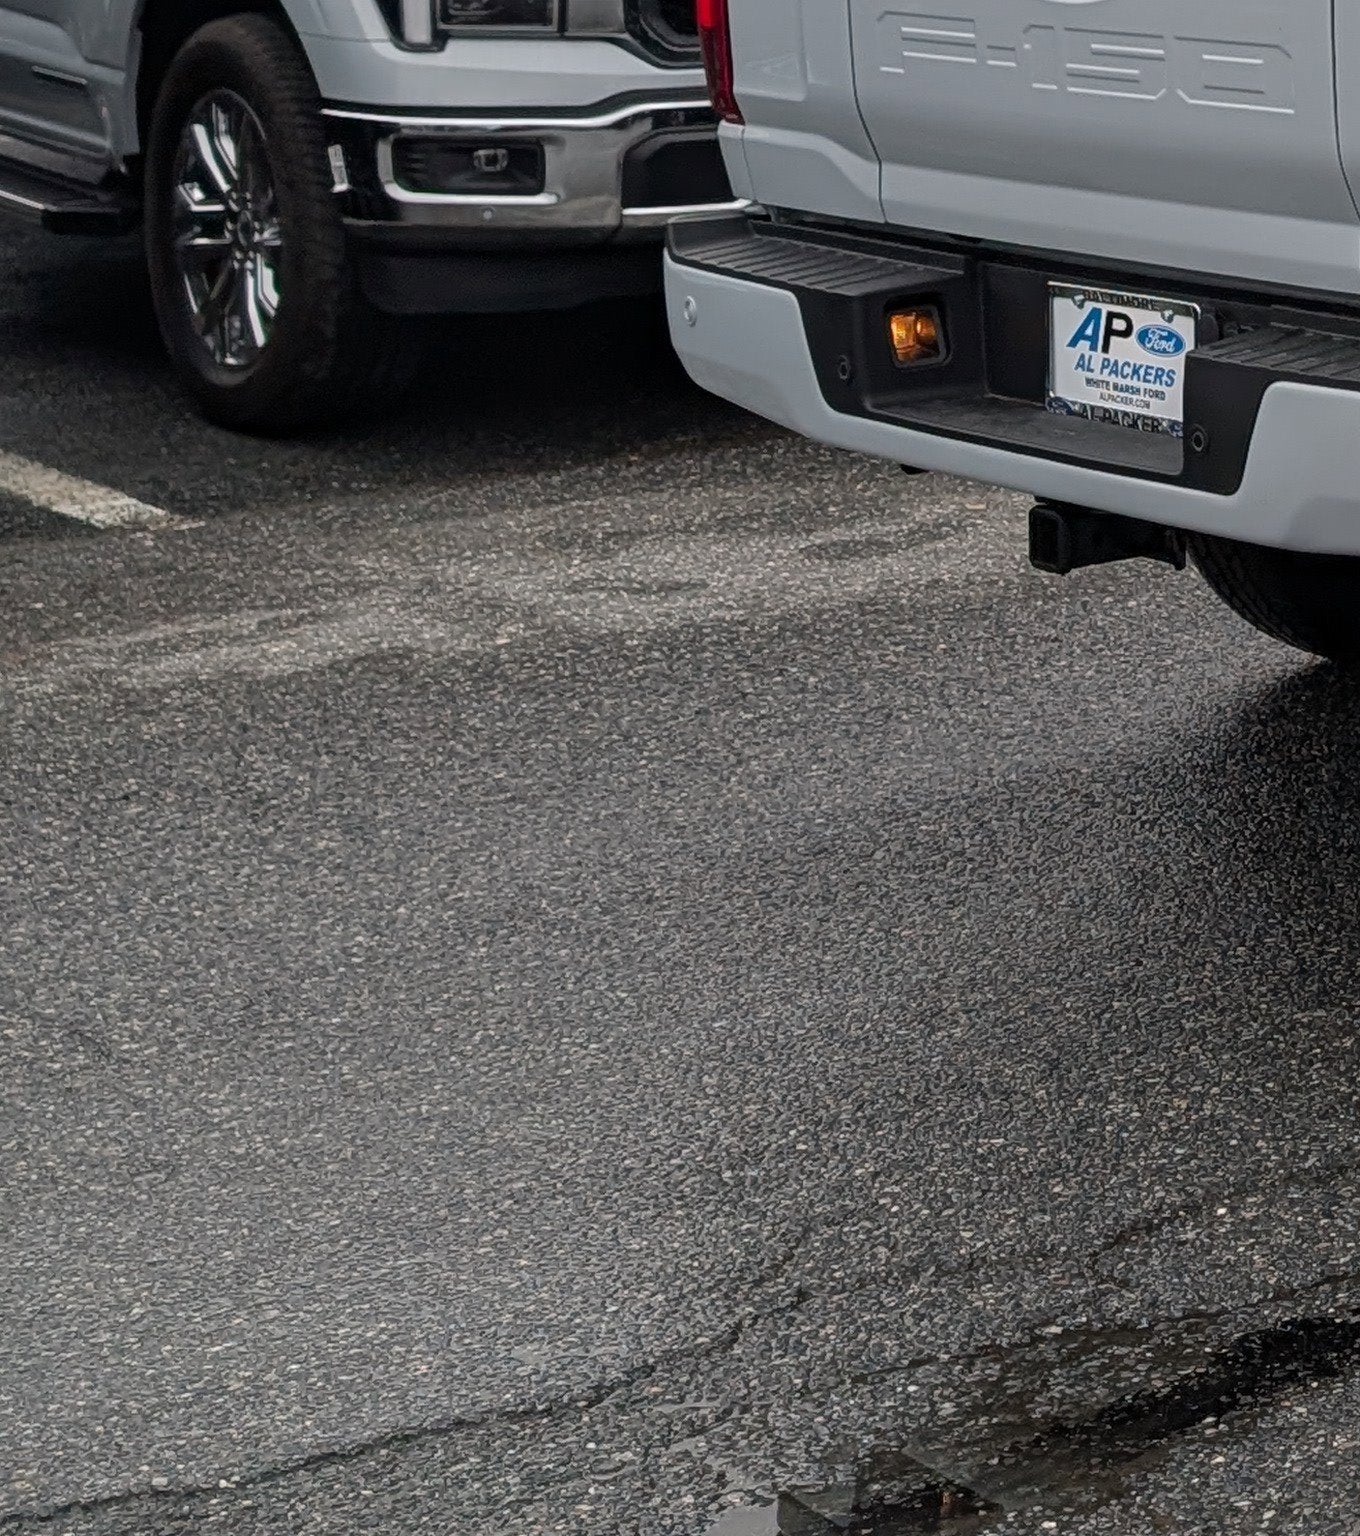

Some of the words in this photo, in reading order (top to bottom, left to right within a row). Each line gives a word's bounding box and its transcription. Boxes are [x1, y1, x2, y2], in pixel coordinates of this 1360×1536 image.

[876, 10, 1295, 115] F-150
[1066, 306, 1134, 354] AP
[1143, 328, 1178, 353] Ford
[1074, 353, 1096, 373] AL
[1100, 357, 1177, 388] PACKERS
[1085, 377, 1111, 390] WHITE
[1112, 382, 1141, 397] MARSH
[1143, 387, 1166, 401] FORD
